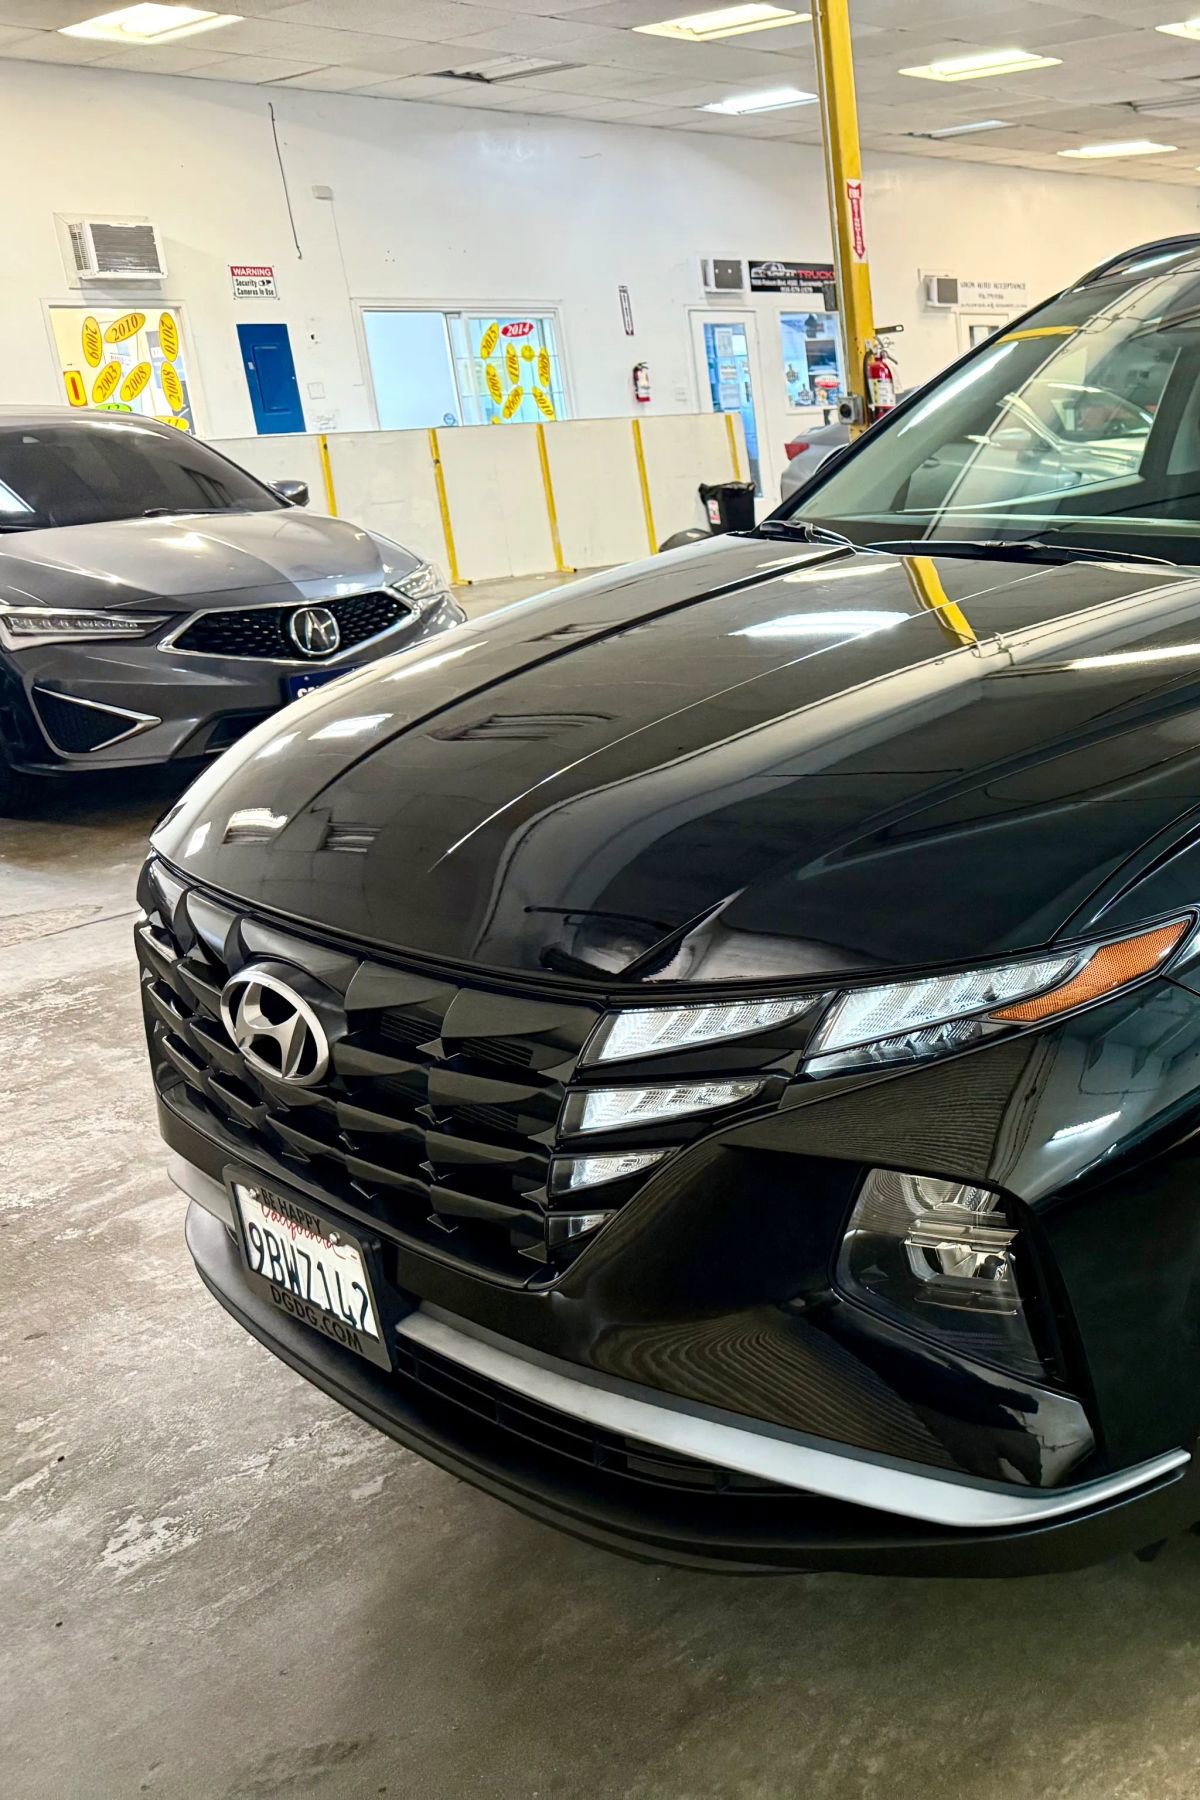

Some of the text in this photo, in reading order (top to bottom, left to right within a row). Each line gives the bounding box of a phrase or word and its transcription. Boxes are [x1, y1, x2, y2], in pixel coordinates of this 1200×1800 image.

[232, 267, 272, 276] WARNING
[235, 278, 257, 288] Security
[799, 270, 835, 279] TRUCK
[85, 324, 100, 360] 2009
[111, 314, 139, 341] 2010
[160, 319, 177, 355] 2010
[507, 323, 530, 336] 2014
[97, 364, 118, 398] 2003
[125, 366, 148, 398] 2008
[261, 1187, 321, 1235] BE HAPPY
[249, 1221, 379, 1343] 9BWZ142
[270, 1284, 364, 1353] DGDG.COM
